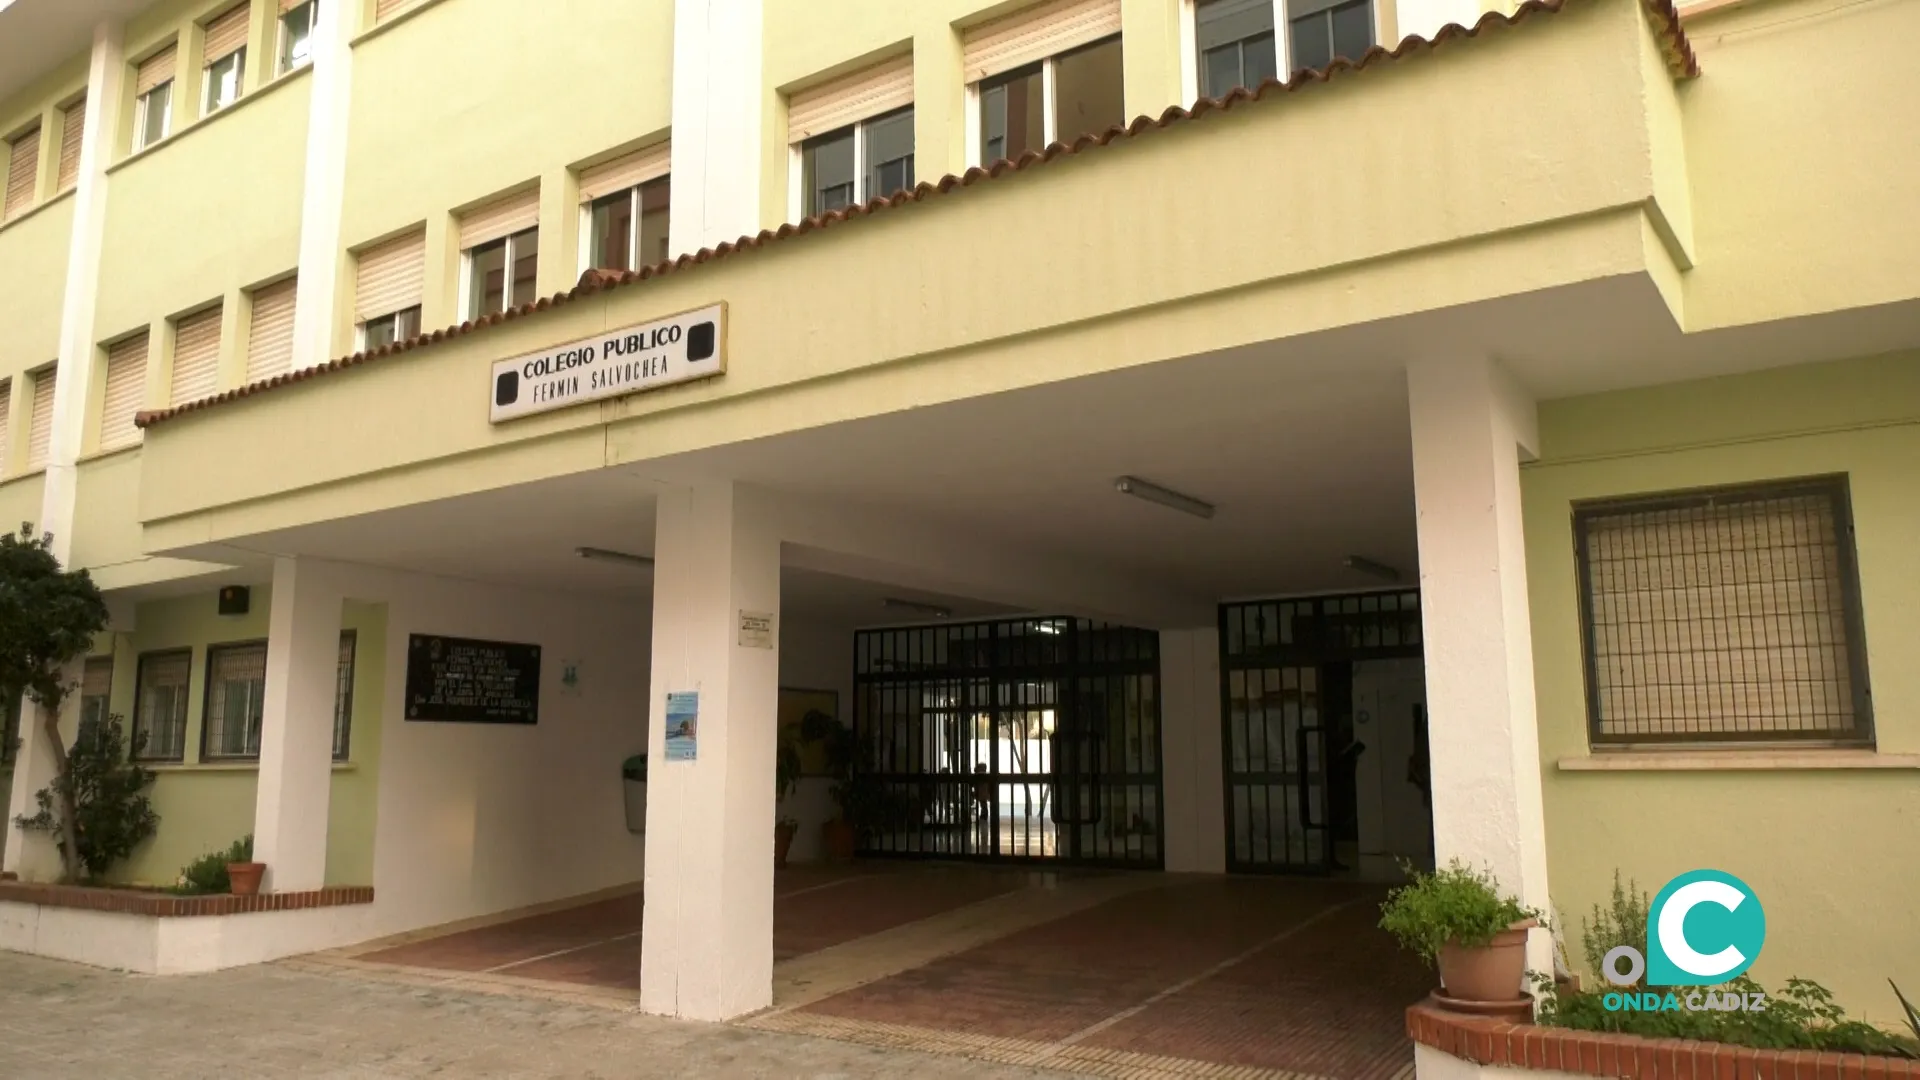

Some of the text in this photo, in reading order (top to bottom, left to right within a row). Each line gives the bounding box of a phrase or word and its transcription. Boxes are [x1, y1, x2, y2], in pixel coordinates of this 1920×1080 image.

[523, 324, 683, 380] COLEGIO PUBLICO
[533, 354, 668, 404] FERMIN SALVOCHEA
